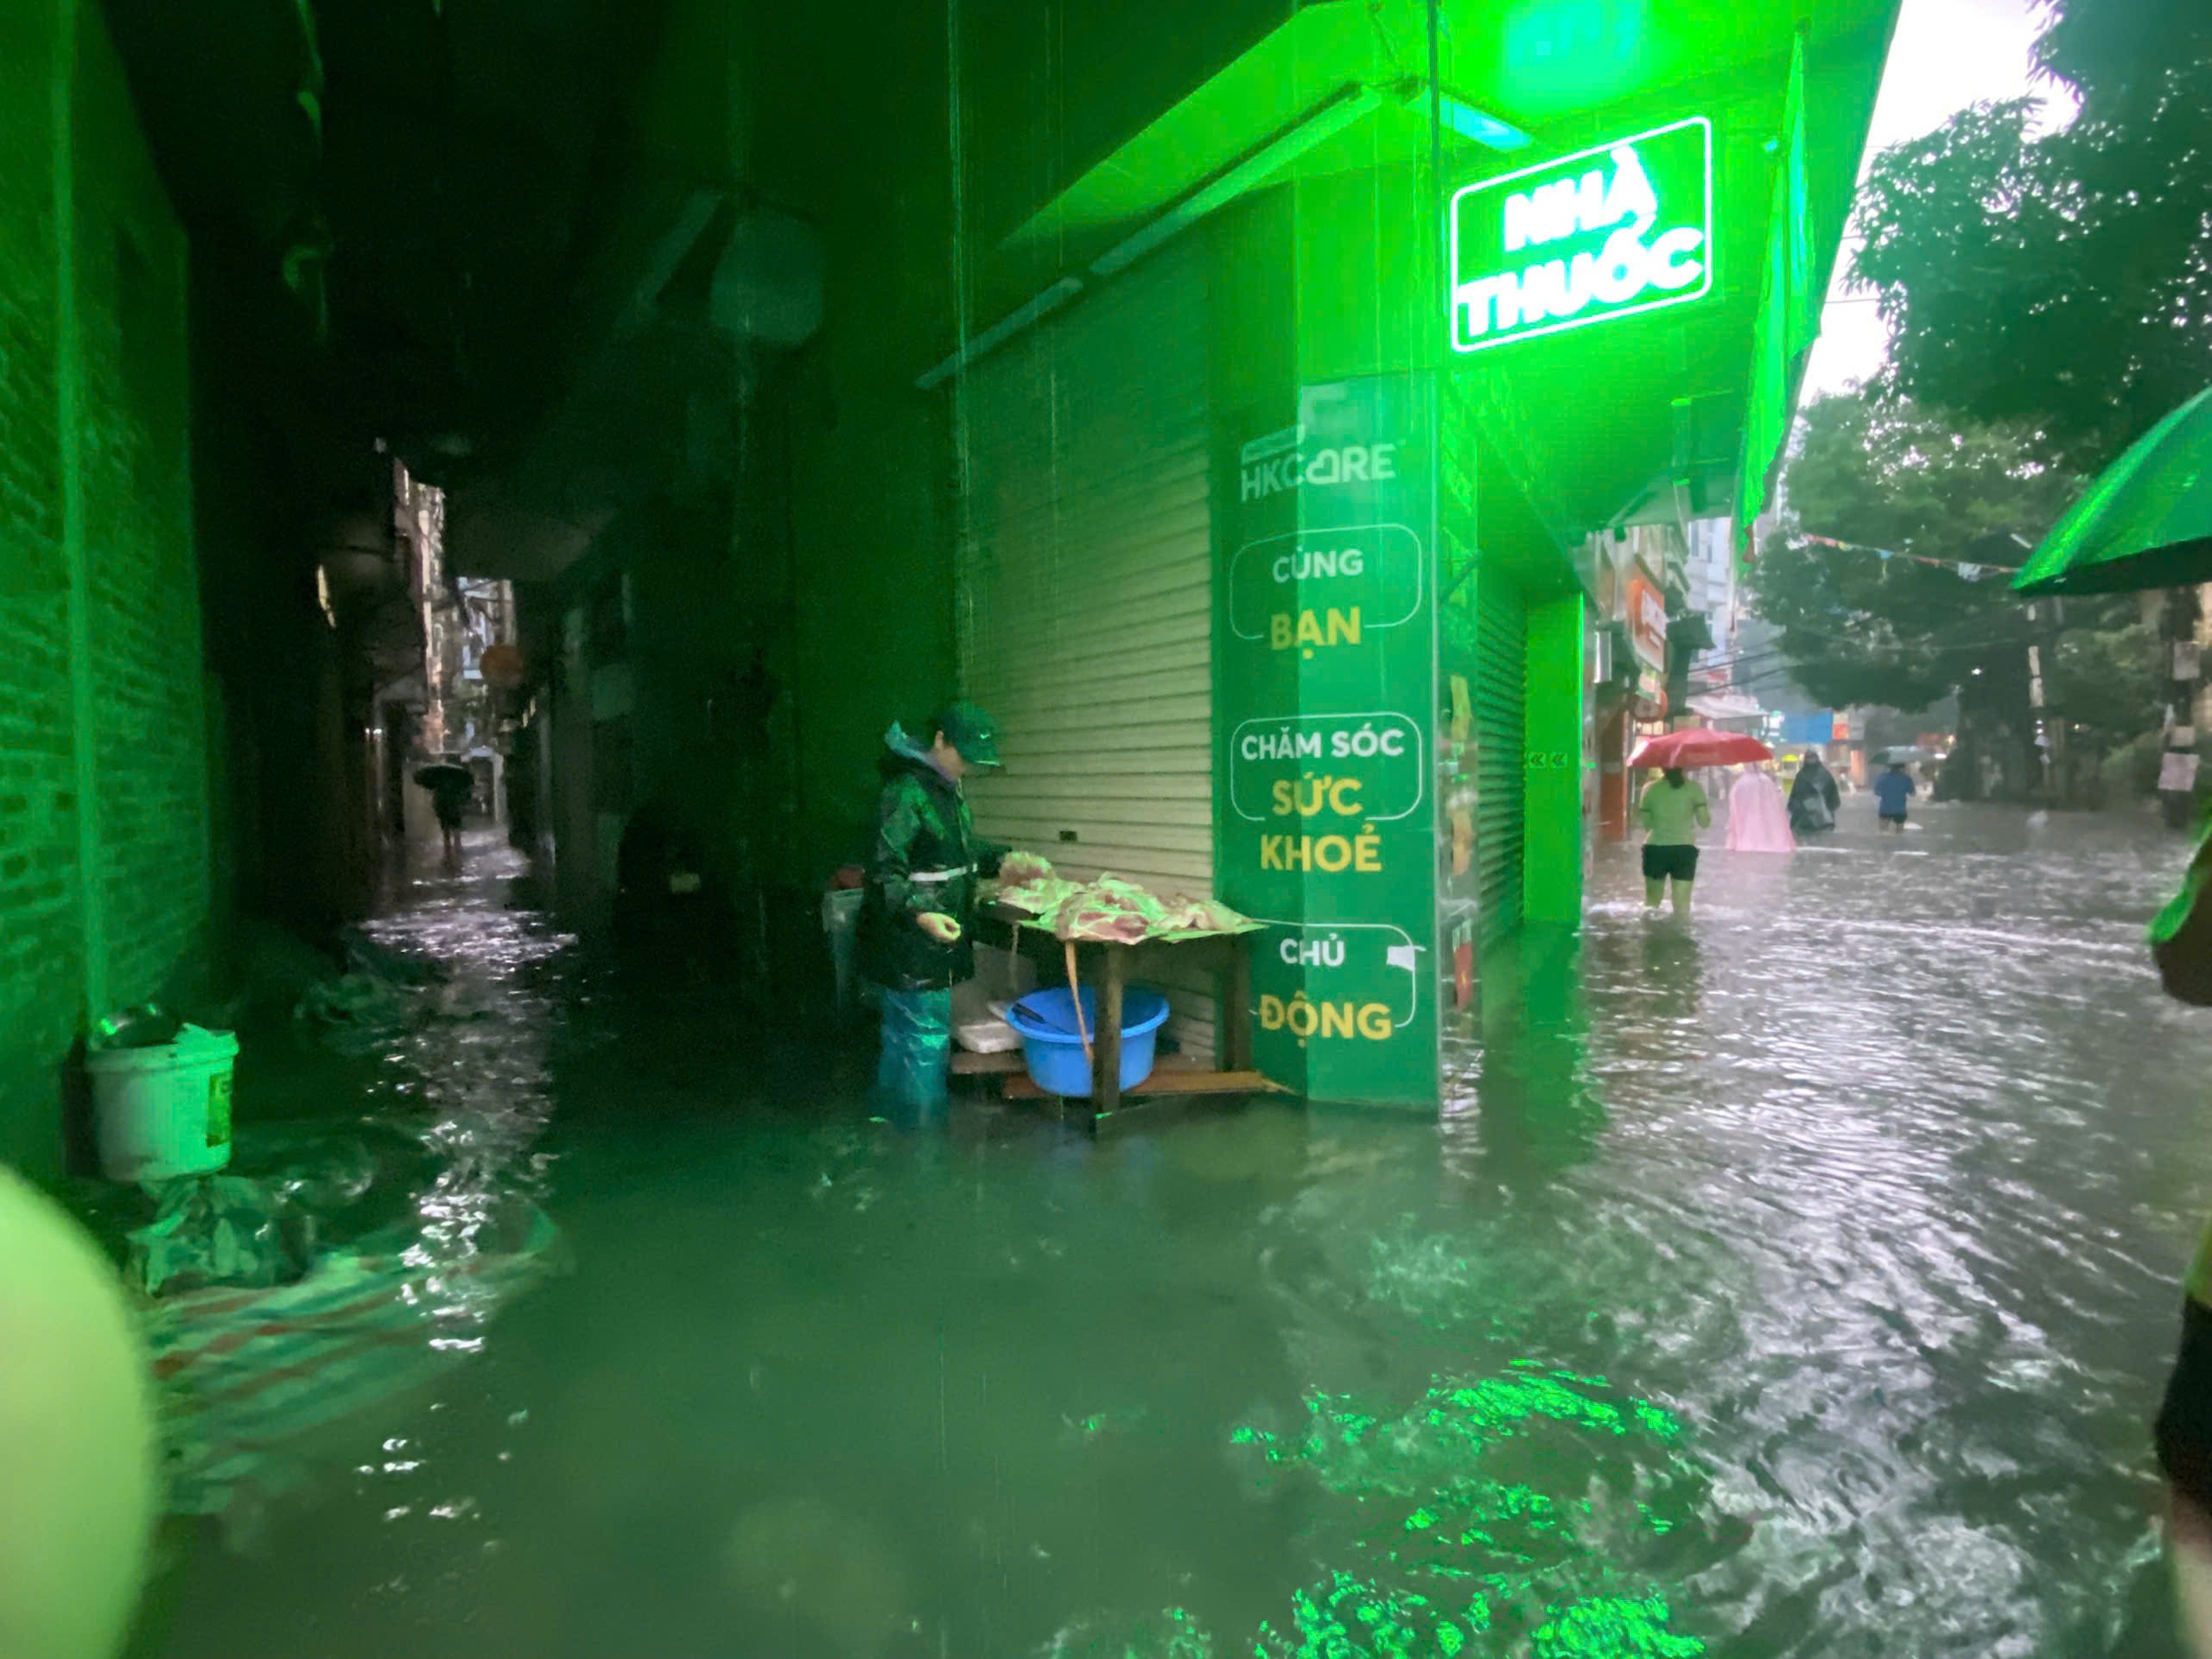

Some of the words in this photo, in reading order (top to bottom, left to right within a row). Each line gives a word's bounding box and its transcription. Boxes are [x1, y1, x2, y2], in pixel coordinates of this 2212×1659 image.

[1503, 143, 1658, 252] NHÀ
[1270, 606, 1363, 660] BẠN
[1241, 726, 1322, 760] CHĂM
[1331, 722, 1405, 758] SÓC
[1272, 772, 1363, 817] SỨC
[1260, 823, 1383, 873] KHOẺ
[1279, 932, 1345, 968] CHỦ
[1258, 990, 1393, 1048] ĐỘNG
